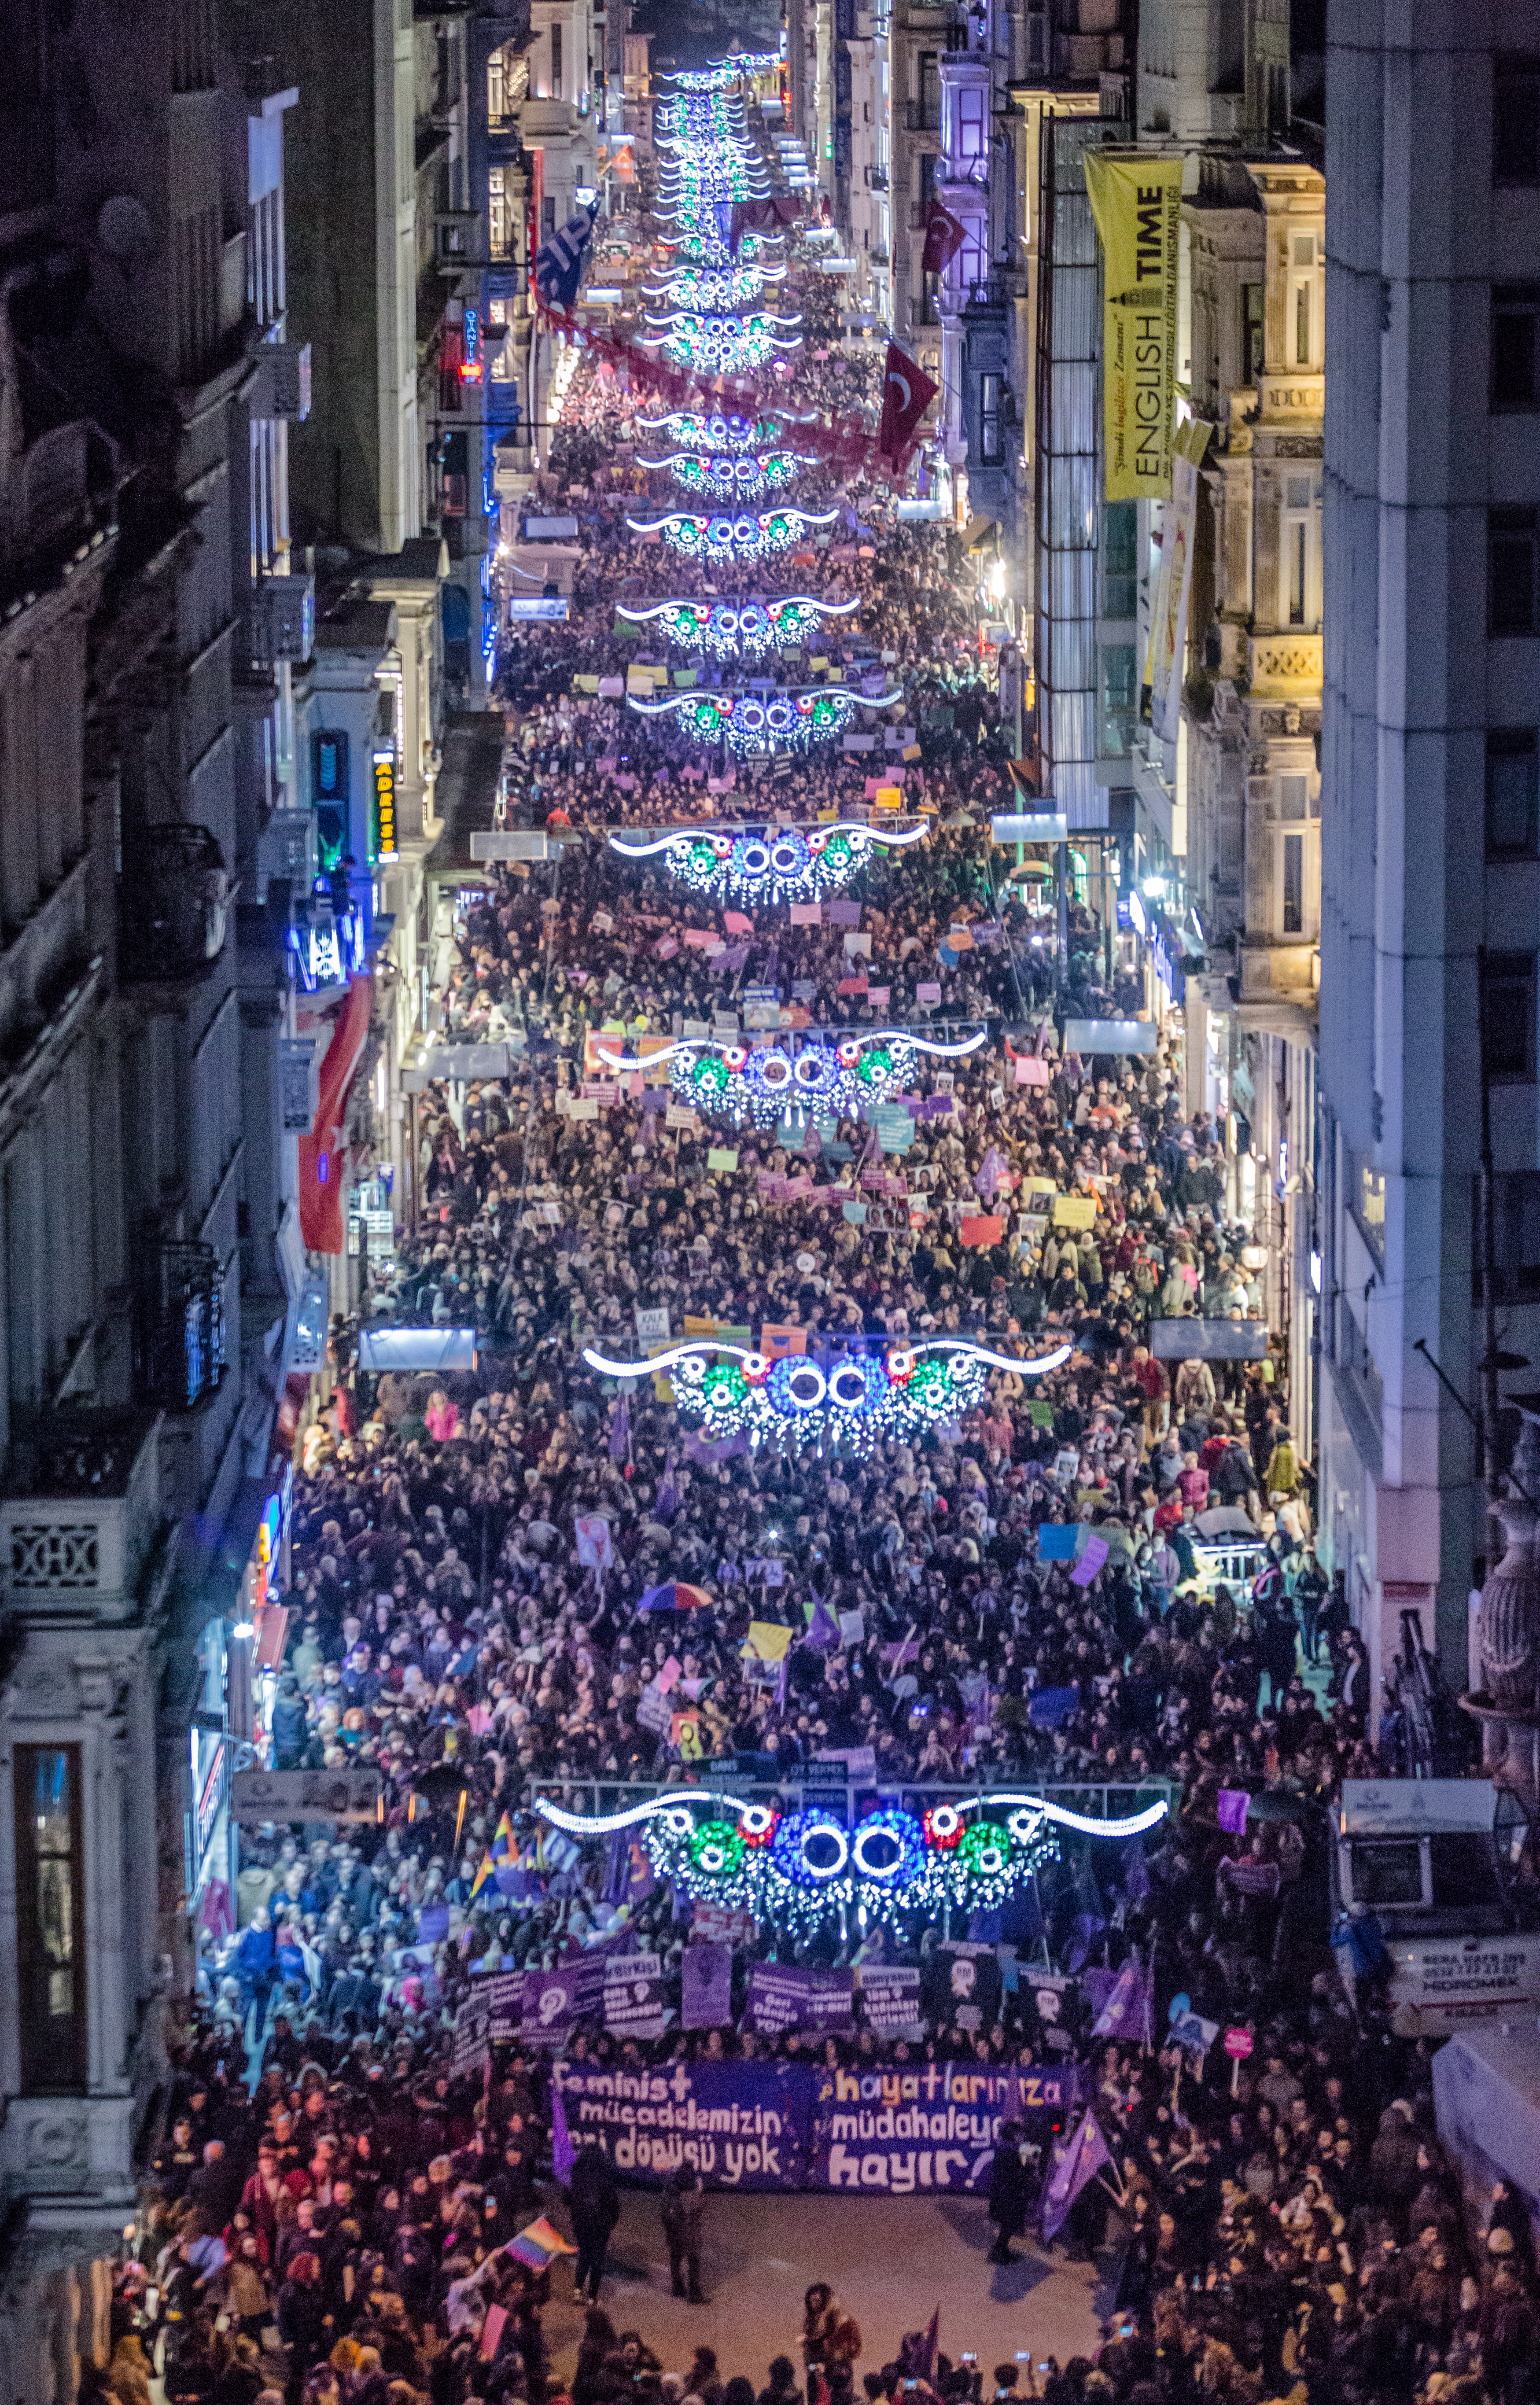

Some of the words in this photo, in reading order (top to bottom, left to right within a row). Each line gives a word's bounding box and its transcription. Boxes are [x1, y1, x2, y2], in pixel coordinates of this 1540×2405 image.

[1137, 186, 1162, 281] TIME
[1136, 316, 1161, 476] ENGLISH
[375, 762, 394, 852] ADRESS
[548, 2062, 692, 2102] feminist
[580, 2098, 781, 2136] mücadelemizin
[721, 2135, 781, 2184] yok
[829, 2144, 995, 2193] hayır!
